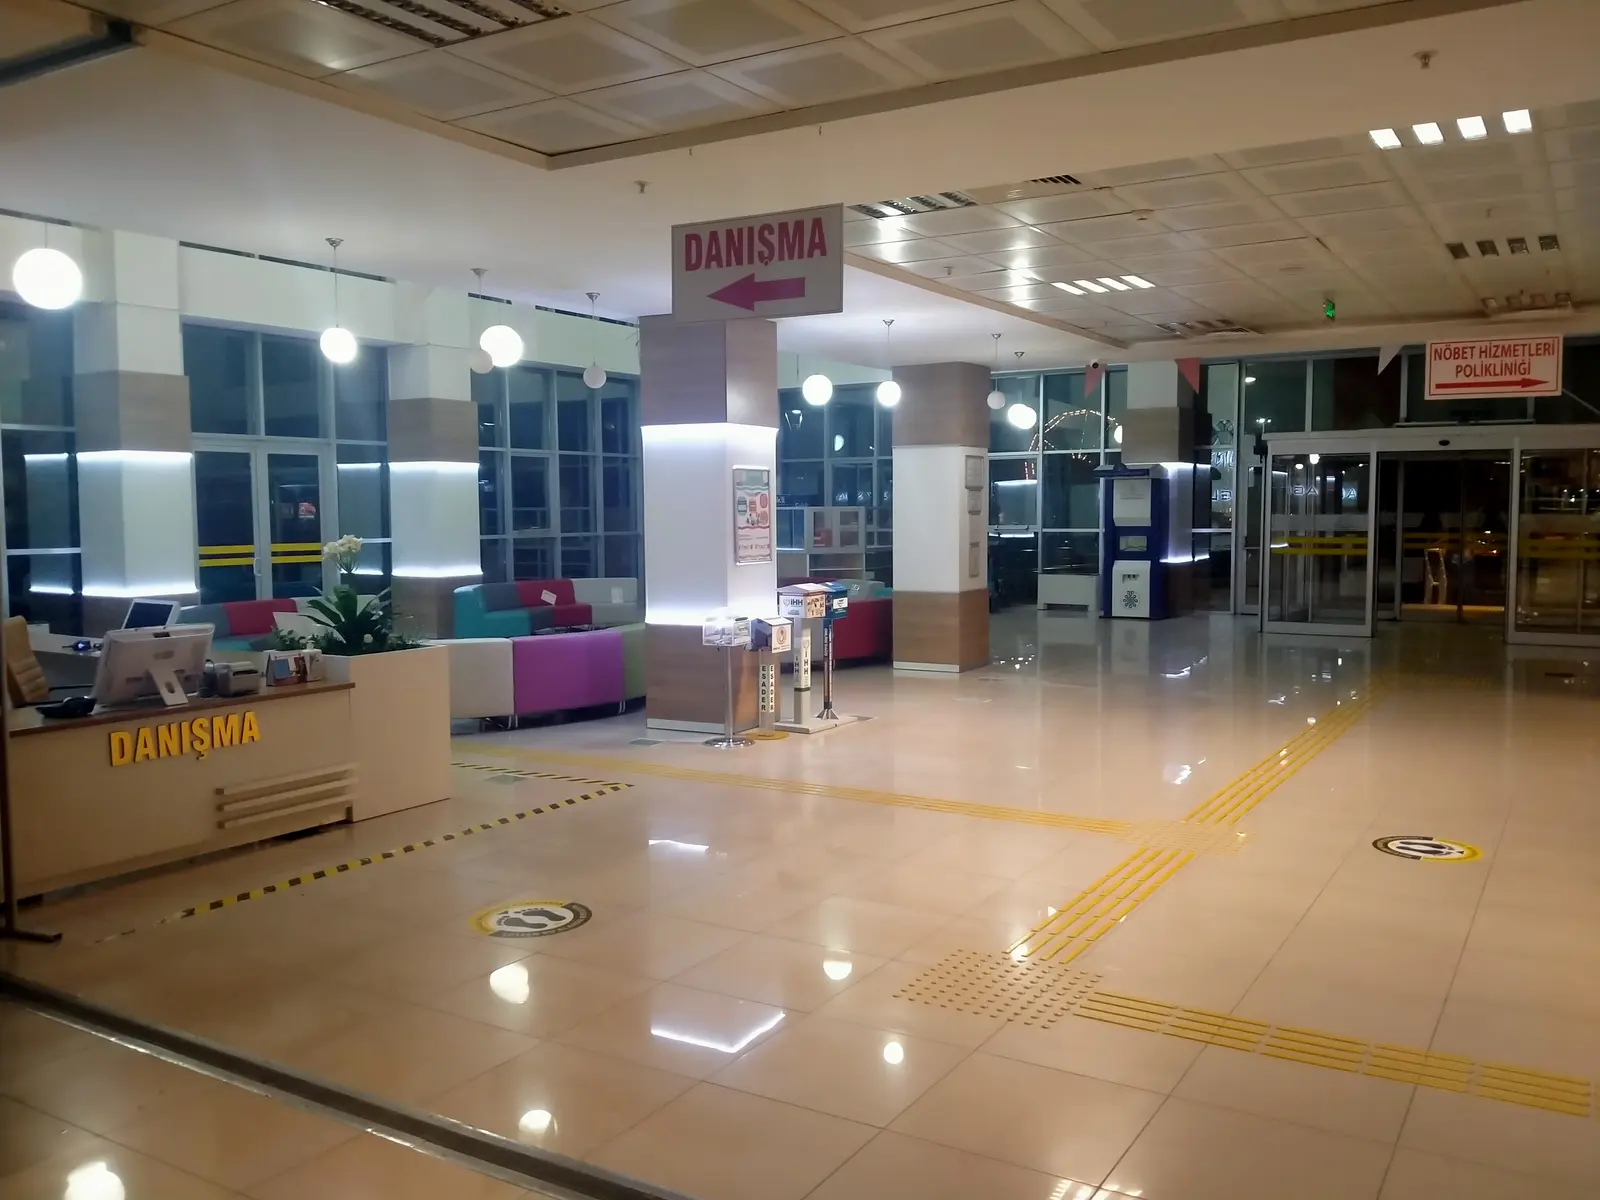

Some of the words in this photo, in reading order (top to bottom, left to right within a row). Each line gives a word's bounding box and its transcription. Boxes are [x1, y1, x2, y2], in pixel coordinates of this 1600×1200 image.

[685, 217, 827, 272] DANIŞMA
[1433, 343, 1476, 361] NÖBET
[1478, 339, 1555, 360] HİZMETLERİ
[1455, 358, 1531, 378] POLİKLİNİĞİ
[109, 711, 261, 767] DANIŞMA
